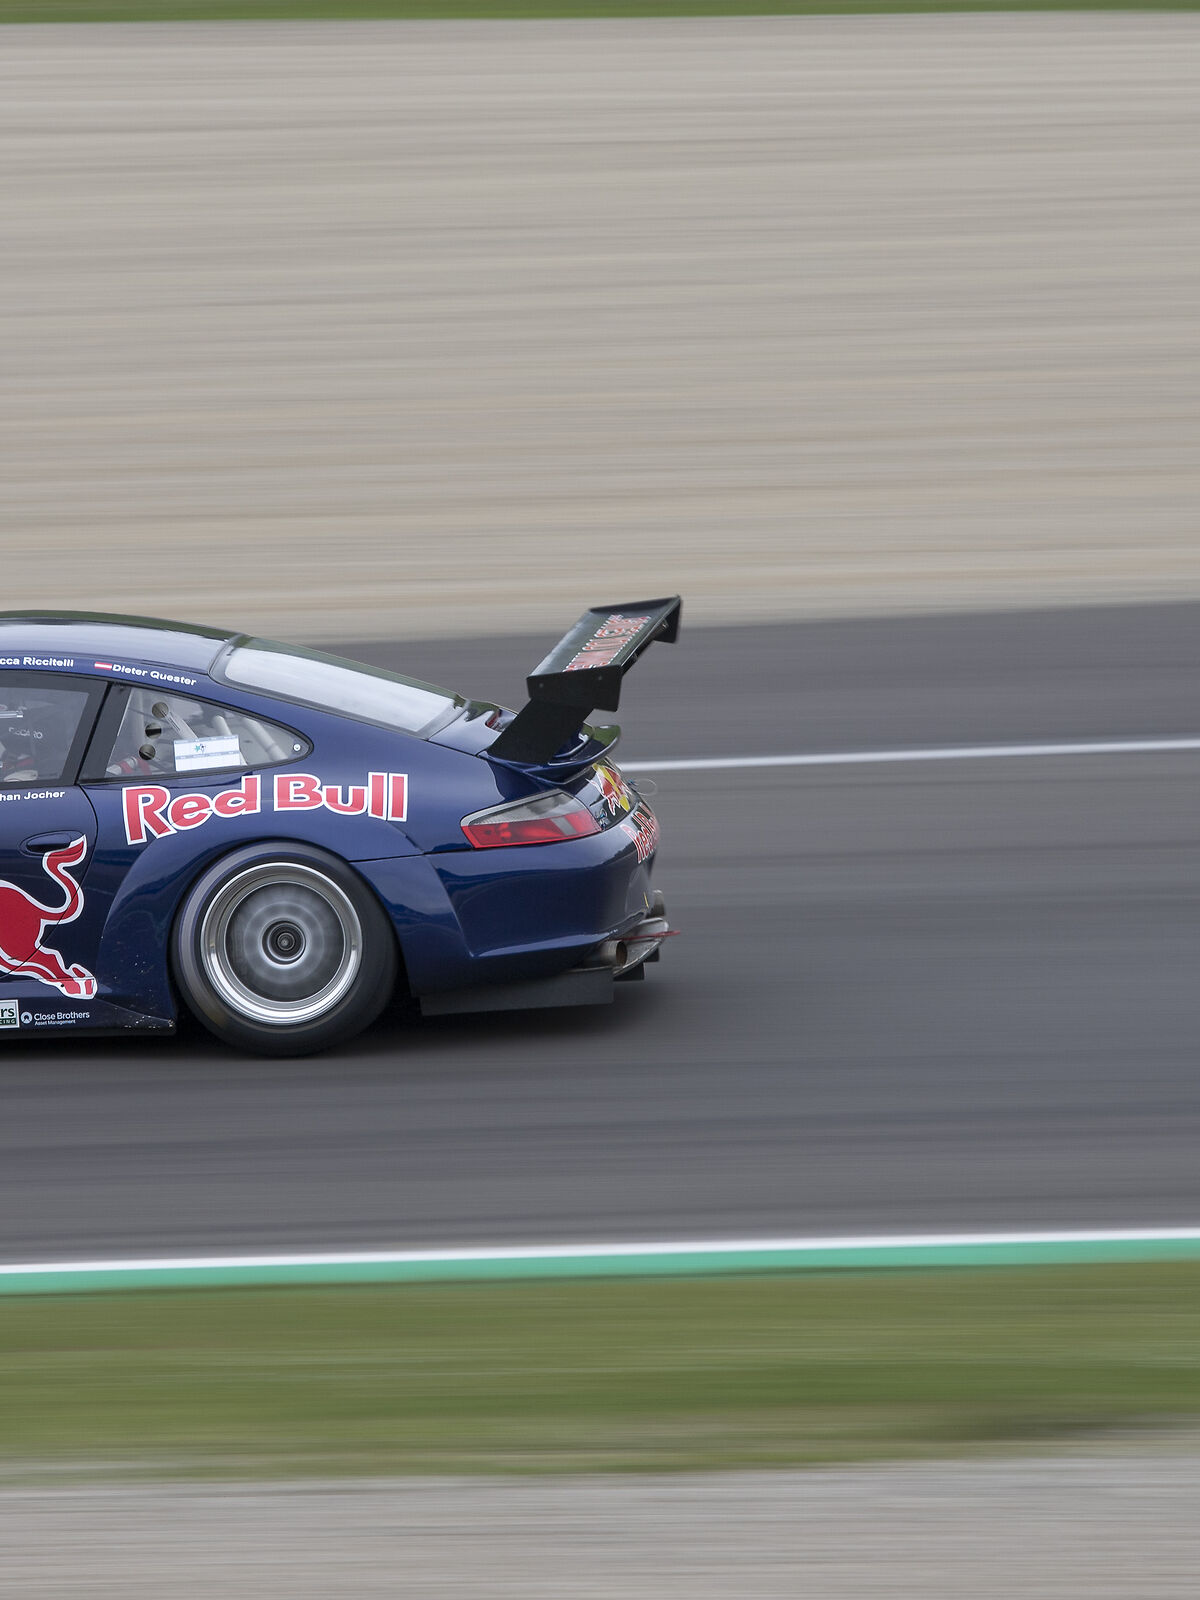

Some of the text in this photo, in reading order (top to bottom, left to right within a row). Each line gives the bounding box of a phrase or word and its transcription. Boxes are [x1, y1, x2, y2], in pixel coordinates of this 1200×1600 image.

[23, 656, 74, 667] Riccitelli
[112, 664, 197, 686] Dieter Quester
[24, 790, 65, 800] Jocher
[122, 772, 408, 845] Red Bull
[33, 1011, 90, 1021] Close Brothers
